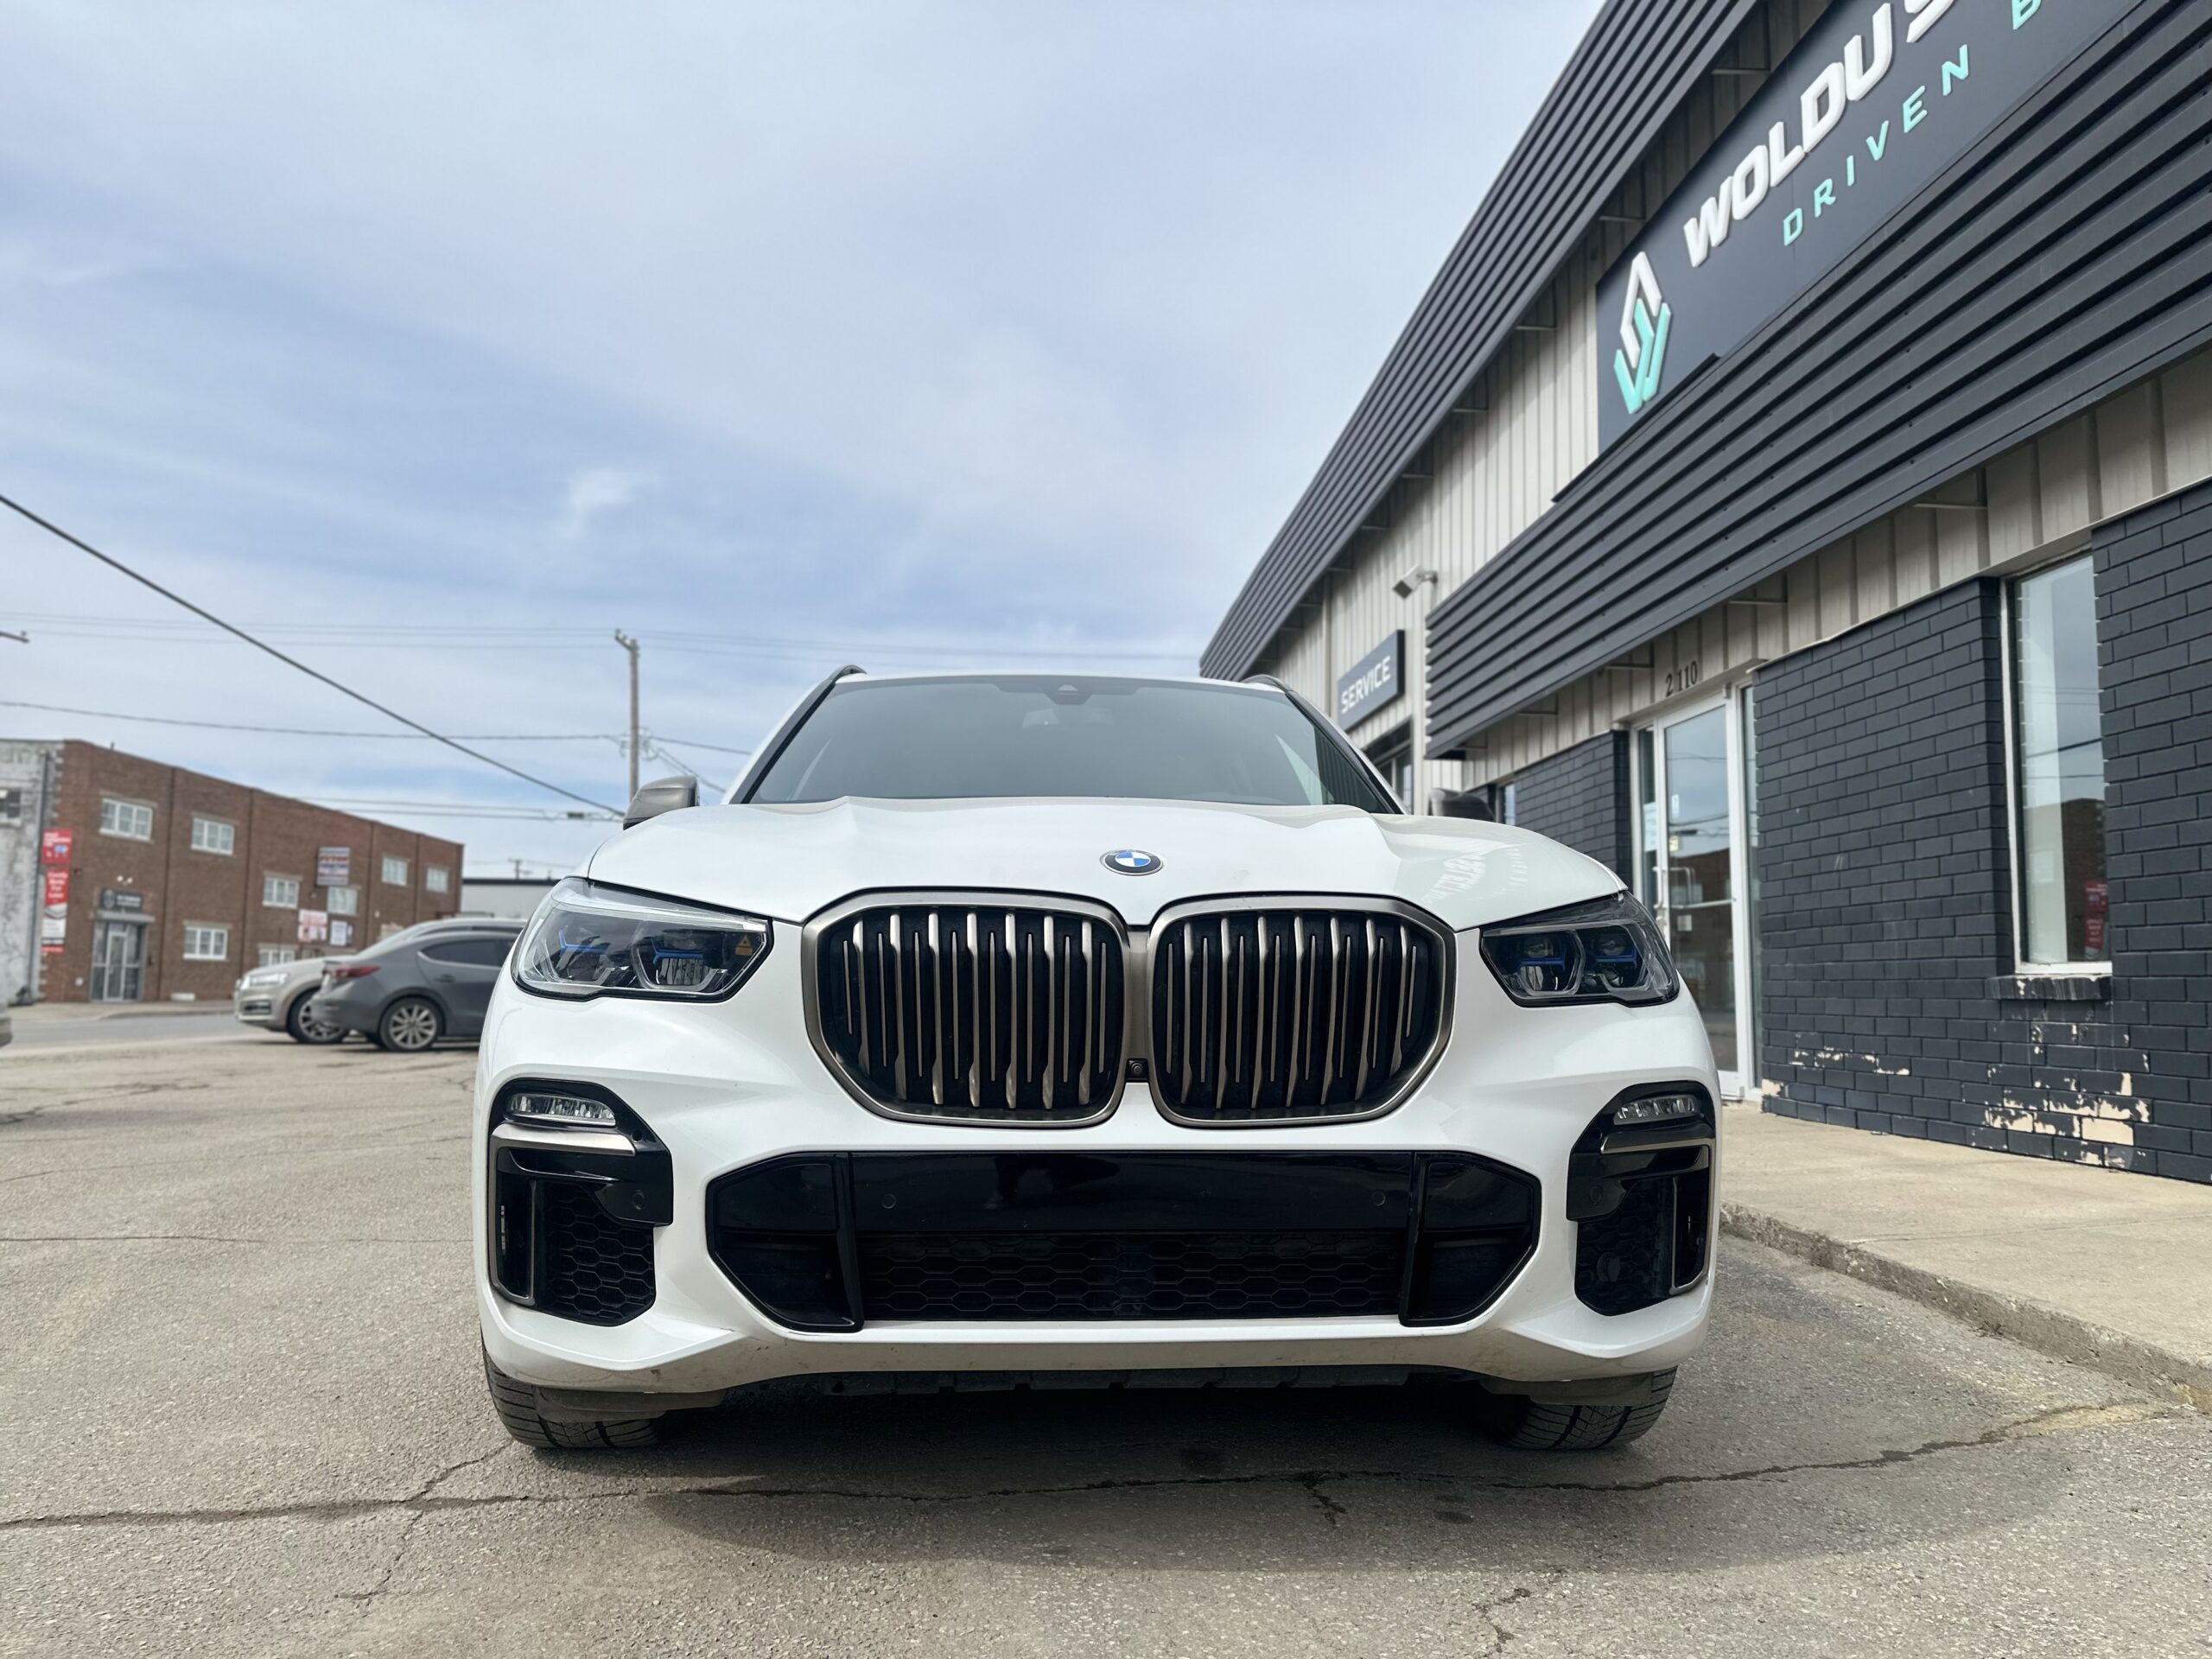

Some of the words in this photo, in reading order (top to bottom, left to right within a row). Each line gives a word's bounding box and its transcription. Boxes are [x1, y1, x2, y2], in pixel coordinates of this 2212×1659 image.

[1783, 44, 1969, 245] DRIVEN
[1341, 655, 1390, 715] SERVICE
[1665, 660, 1697, 697] 2110
